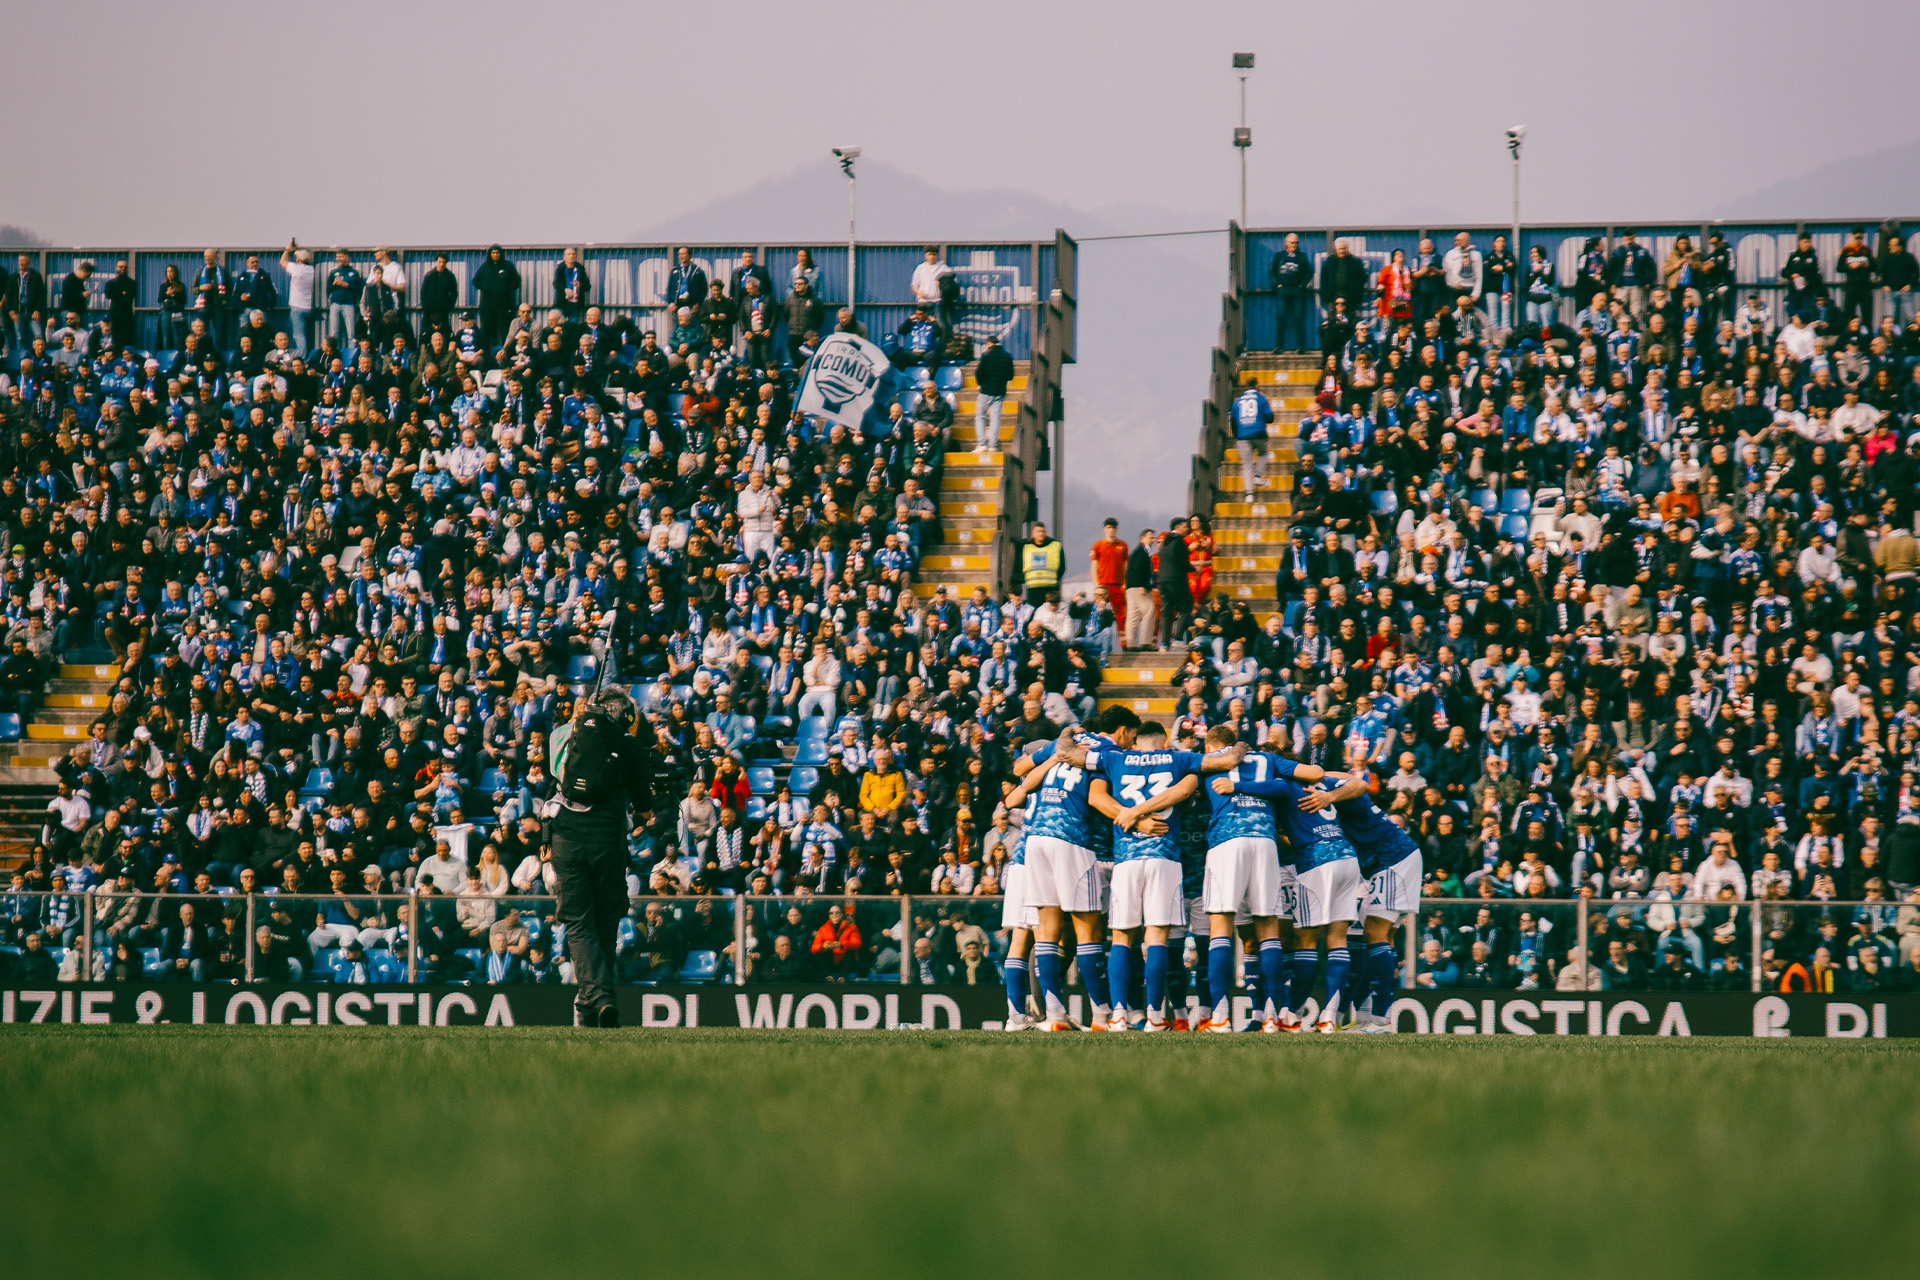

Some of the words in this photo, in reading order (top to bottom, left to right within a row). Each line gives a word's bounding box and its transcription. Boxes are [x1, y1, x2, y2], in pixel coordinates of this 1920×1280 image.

[821, 354, 868, 383] COMO
[1045, 762, 1083, 792] 14
[1120, 771, 1174, 820] 33
[1387, 998, 1692, 1036] OGISTICA
